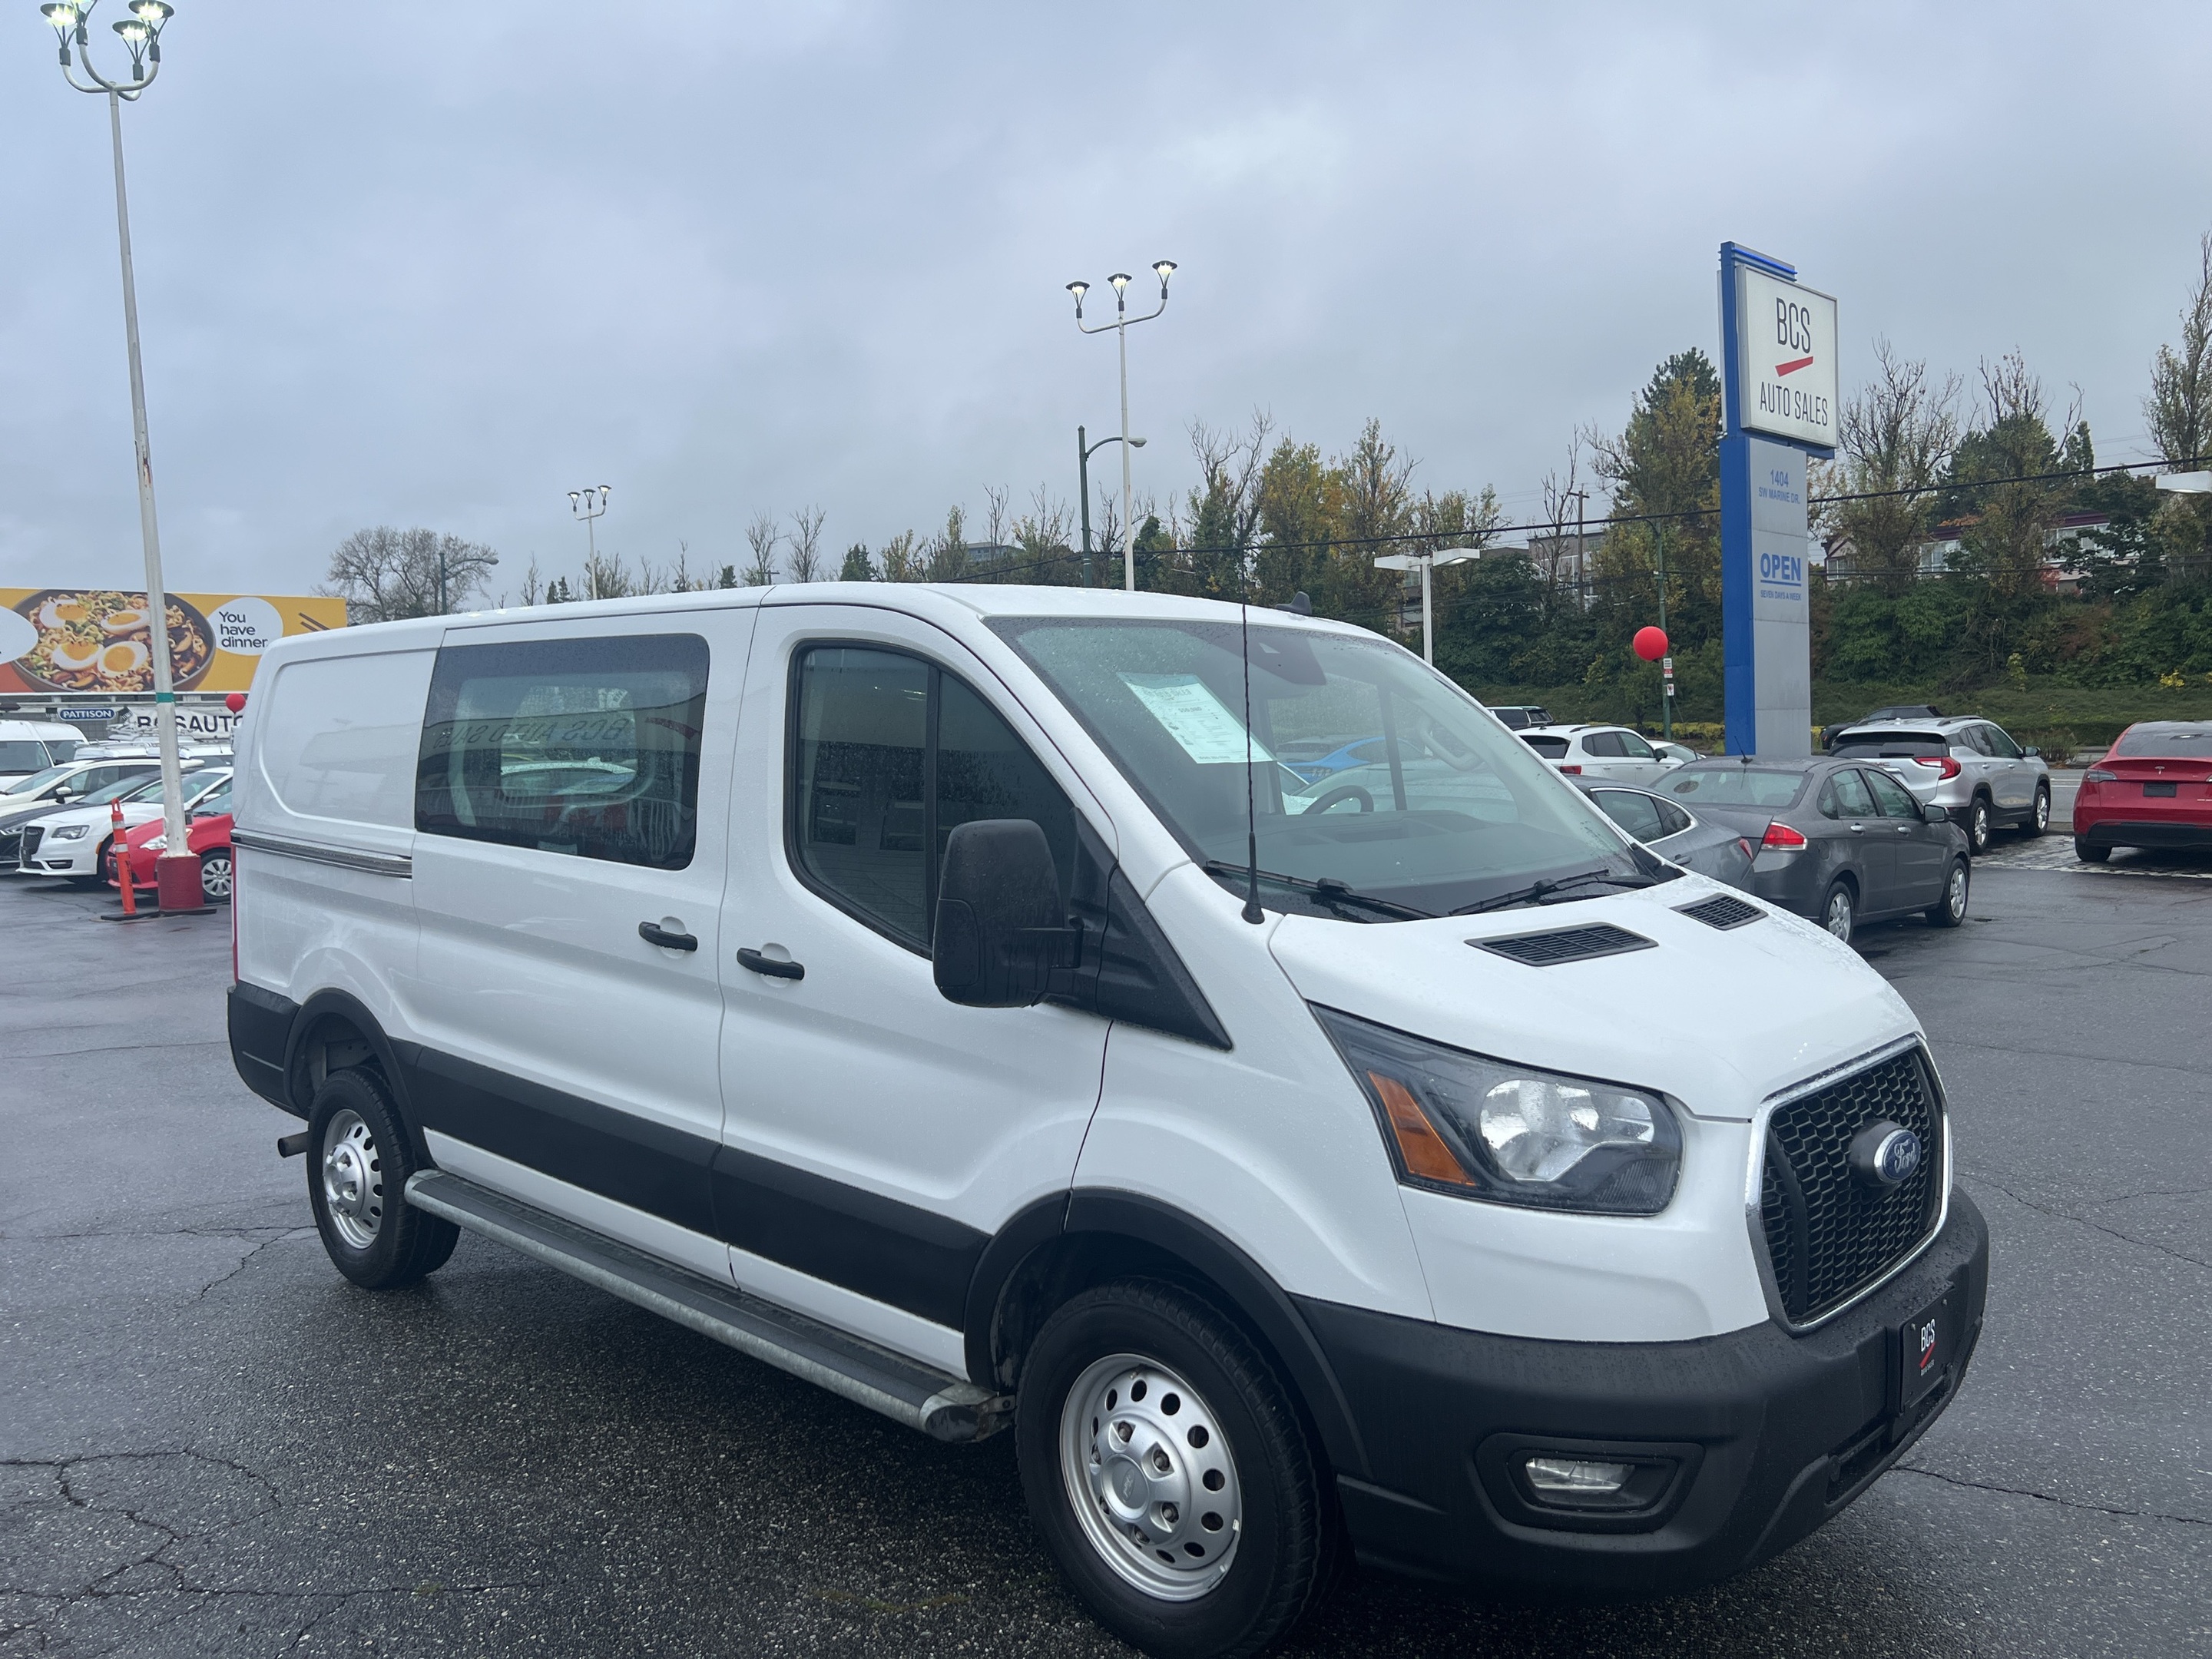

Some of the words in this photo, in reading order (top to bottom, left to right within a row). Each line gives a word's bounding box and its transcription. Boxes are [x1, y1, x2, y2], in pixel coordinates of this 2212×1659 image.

[1776, 296, 1811, 354] BCS
[1760, 381, 1790, 418] AUTO
[1794, 390, 1828, 426] SALES
[1770, 469, 1789, 488] 1404
[1758, 486, 1767, 498] SW
[1768, 488, 1790, 502] MARINE
[1760, 552, 1801, 581] OPEN
[1760, 589, 1774, 598] SEVEN
[1774, 591, 1785, 600] DAYS
[1790, 592, 1802, 601] WEEK
[219, 611, 246, 623] You
[220, 624, 256, 635] have
[63, 710, 112, 718] PATTISON
[1893, 1138, 1917, 1174] Ford
[1921, 1318, 1936, 1352] BCS
